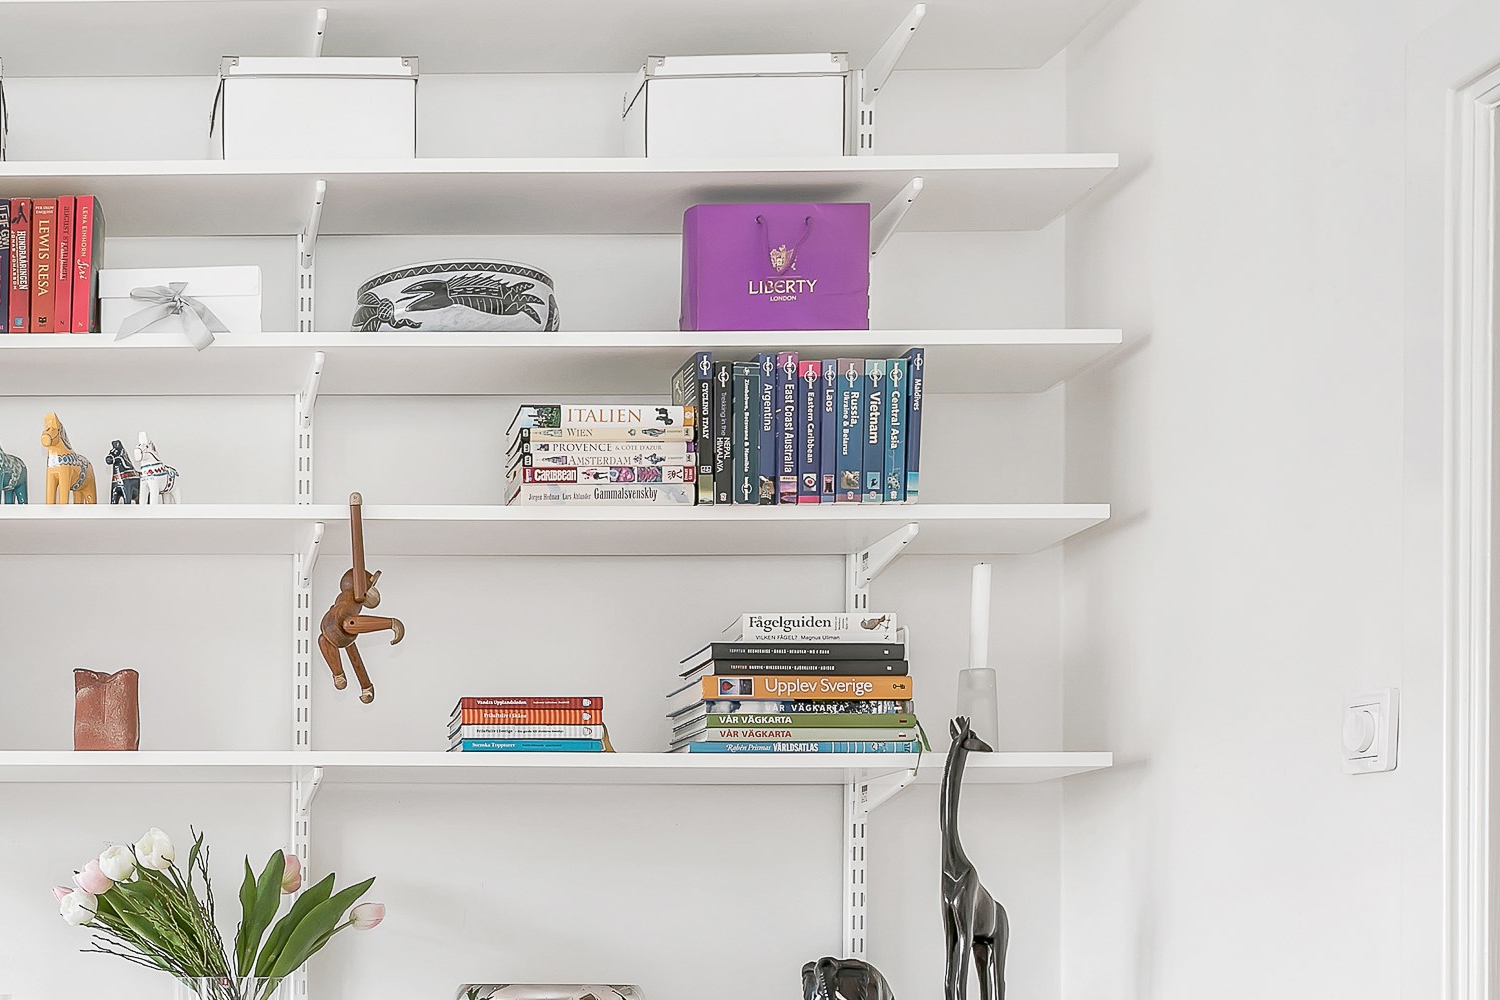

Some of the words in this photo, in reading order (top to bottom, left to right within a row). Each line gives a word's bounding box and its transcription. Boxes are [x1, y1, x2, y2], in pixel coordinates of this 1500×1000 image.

[1, 229, 9, 246] GW
[38, 220, 50, 260] LEWIS
[17, 230, 28, 290] HUNDRAÅRINGEN
[37, 264, 48, 296] RESA
[749, 279, 818, 294] LIBERTY
[785, 384, 795, 403] East
[826, 389, 834, 413] Laos
[913, 378, 922, 411] Maldives
[567, 409, 641, 423] ITALIEN
[762, 384, 773, 432] Argentina
[850, 392, 860, 428] Russia,
[869, 391, 881, 444] Vietnam
[891, 391, 900, 426] Central
[785, 405, 795, 431] Coast
[566, 428, 593, 437] WIEN
[891, 428, 900, 450] Asia
[552, 443, 612, 452] PROVENCE
[807, 423, 815, 463] Caribbean
[567, 455, 631, 466] AMSTERDAM
[784, 433, 795, 473] Australia
[593, 487, 657, 501] Gammalsvenskby
[749, 616, 831, 632] Fågelguiden
[765, 678, 817, 696] Upplev
[820, 678, 873, 696] Sverige
[791, 703, 845, 712] VÄGKARTA
[719, 715, 739, 724] VÅR
[741, 715, 792, 724] VÄGKARTA
[720, 729, 739, 737] VÅR
[742, 729, 792, 738] VÄGKARTA
[725, 743, 746, 752] Rabén
[747, 743, 772, 751] Prismas
[772, 743, 818, 752] VÄRLDSATLAS
